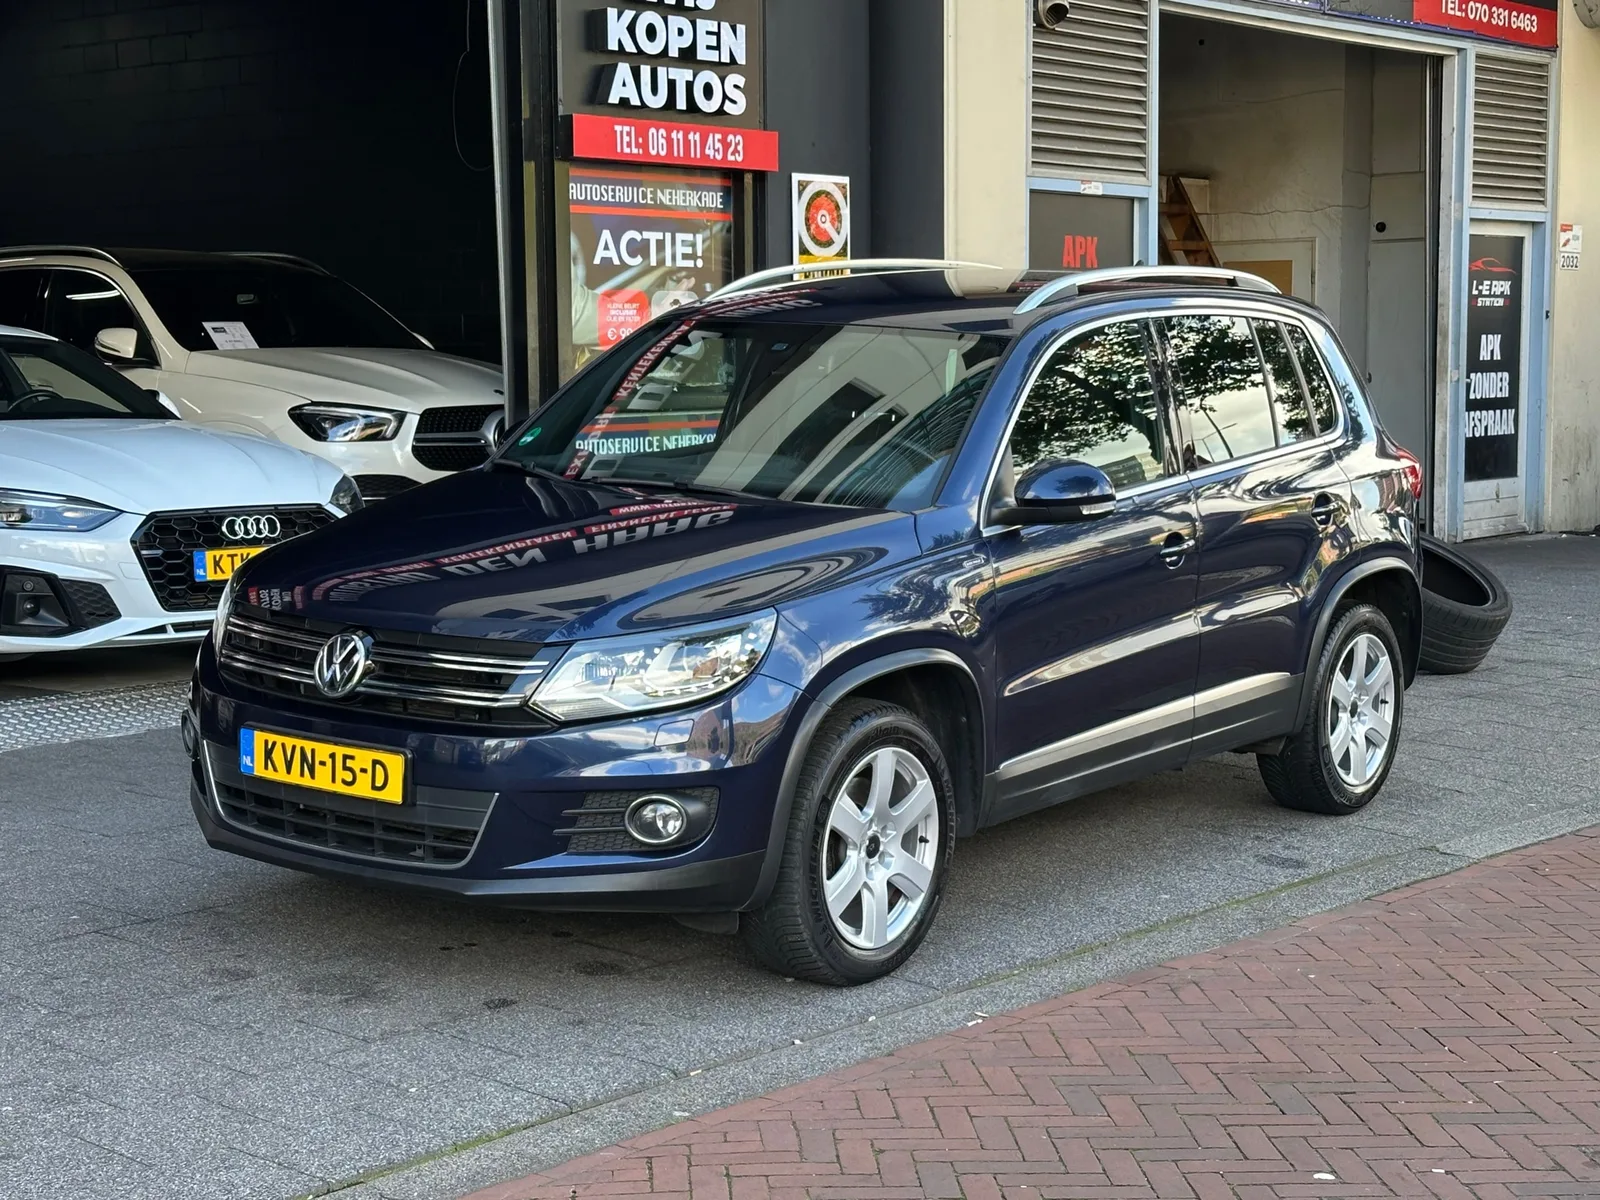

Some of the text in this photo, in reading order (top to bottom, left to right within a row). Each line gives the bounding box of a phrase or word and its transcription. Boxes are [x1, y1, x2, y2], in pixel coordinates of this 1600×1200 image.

[1441, 0, 1466, 17] TEL:
[1468, 1, 1489, 23] 070
[1491, 6, 1509, 27] 331
[1511, 10, 1538, 33] 6463
[606, 8, 747, 65] KOPEN
[608, 62, 747, 116] AUTOS
[614, 125, 744, 162] TEL: 06 11 11 45 23
[568, 182, 724, 209] AUTOSERVICE NEHERKADE
[593, 229, 704, 268] ACTIE!
[1062, 235, 1099, 269] APK
[1561, 255, 1579, 269] 2032
[1471, 280, 1512, 296] L-E APK
[1476, 297, 1505, 307] STATION
[1479, 334, 1501, 361] APK
[1469, 372, 1510, 399] ZONDER
[196, 568, 206, 576] NL
[242, 738, 390, 793] NL KVN-15-D
